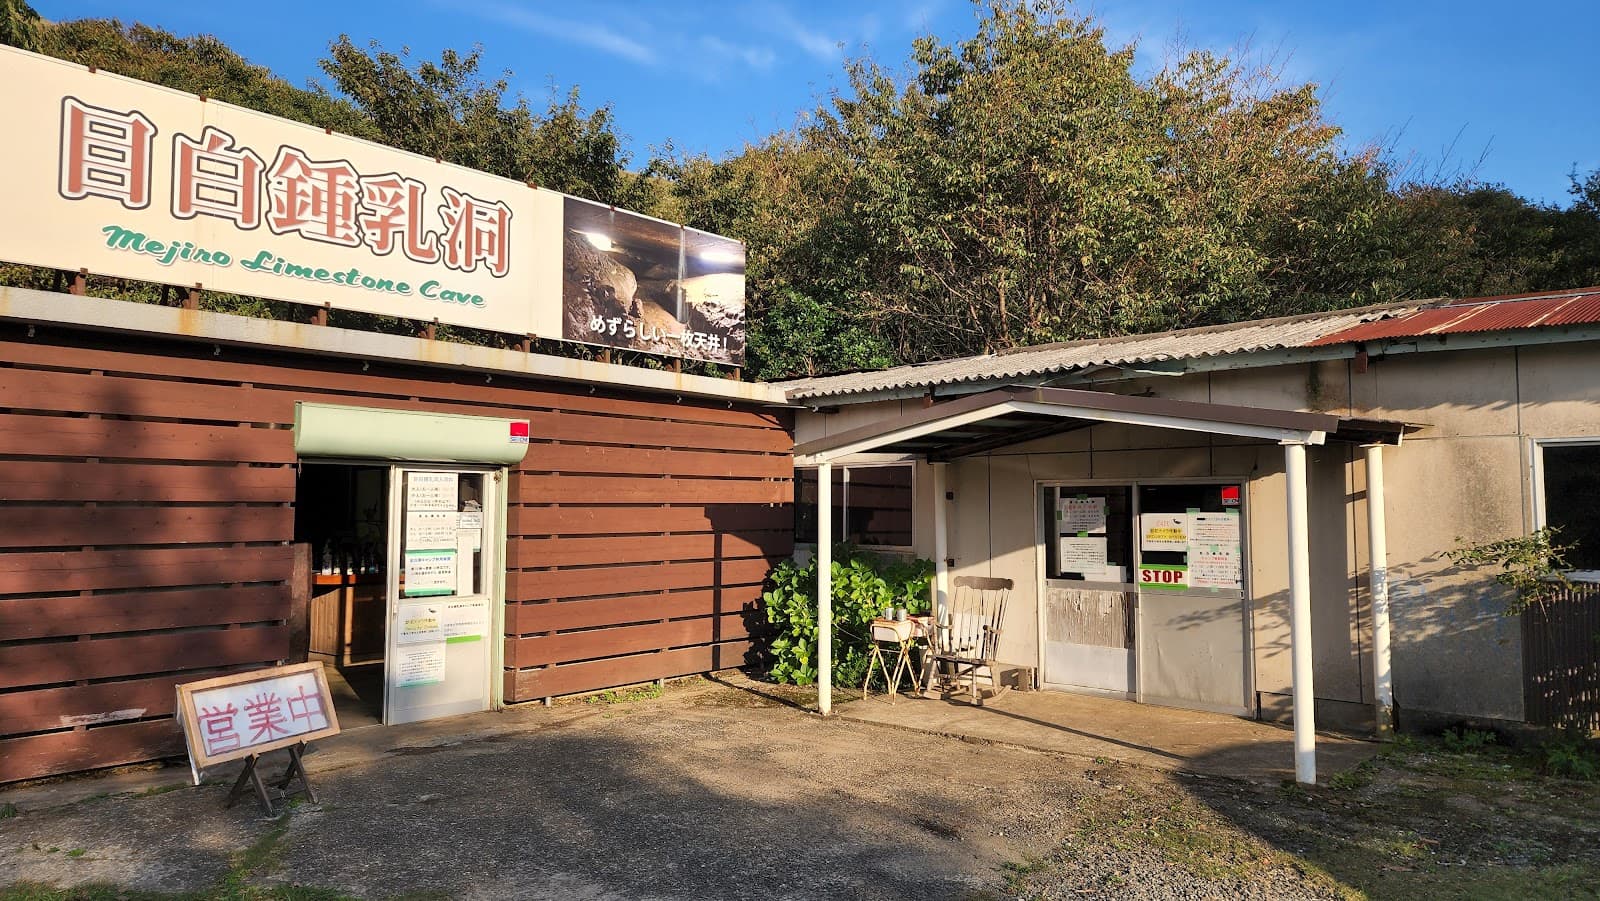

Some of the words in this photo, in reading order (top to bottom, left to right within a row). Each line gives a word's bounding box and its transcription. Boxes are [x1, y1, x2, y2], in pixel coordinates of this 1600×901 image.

[59, 96, 512, 277] 目白鍾乳洞
[102, 224, 231, 265] Mejiro
[241, 250, 411, 294] Limestone
[419, 280, 485, 307] Cave
[1142, 569, 1183, 583] STOP
[199, 685, 322, 754] 営業中
